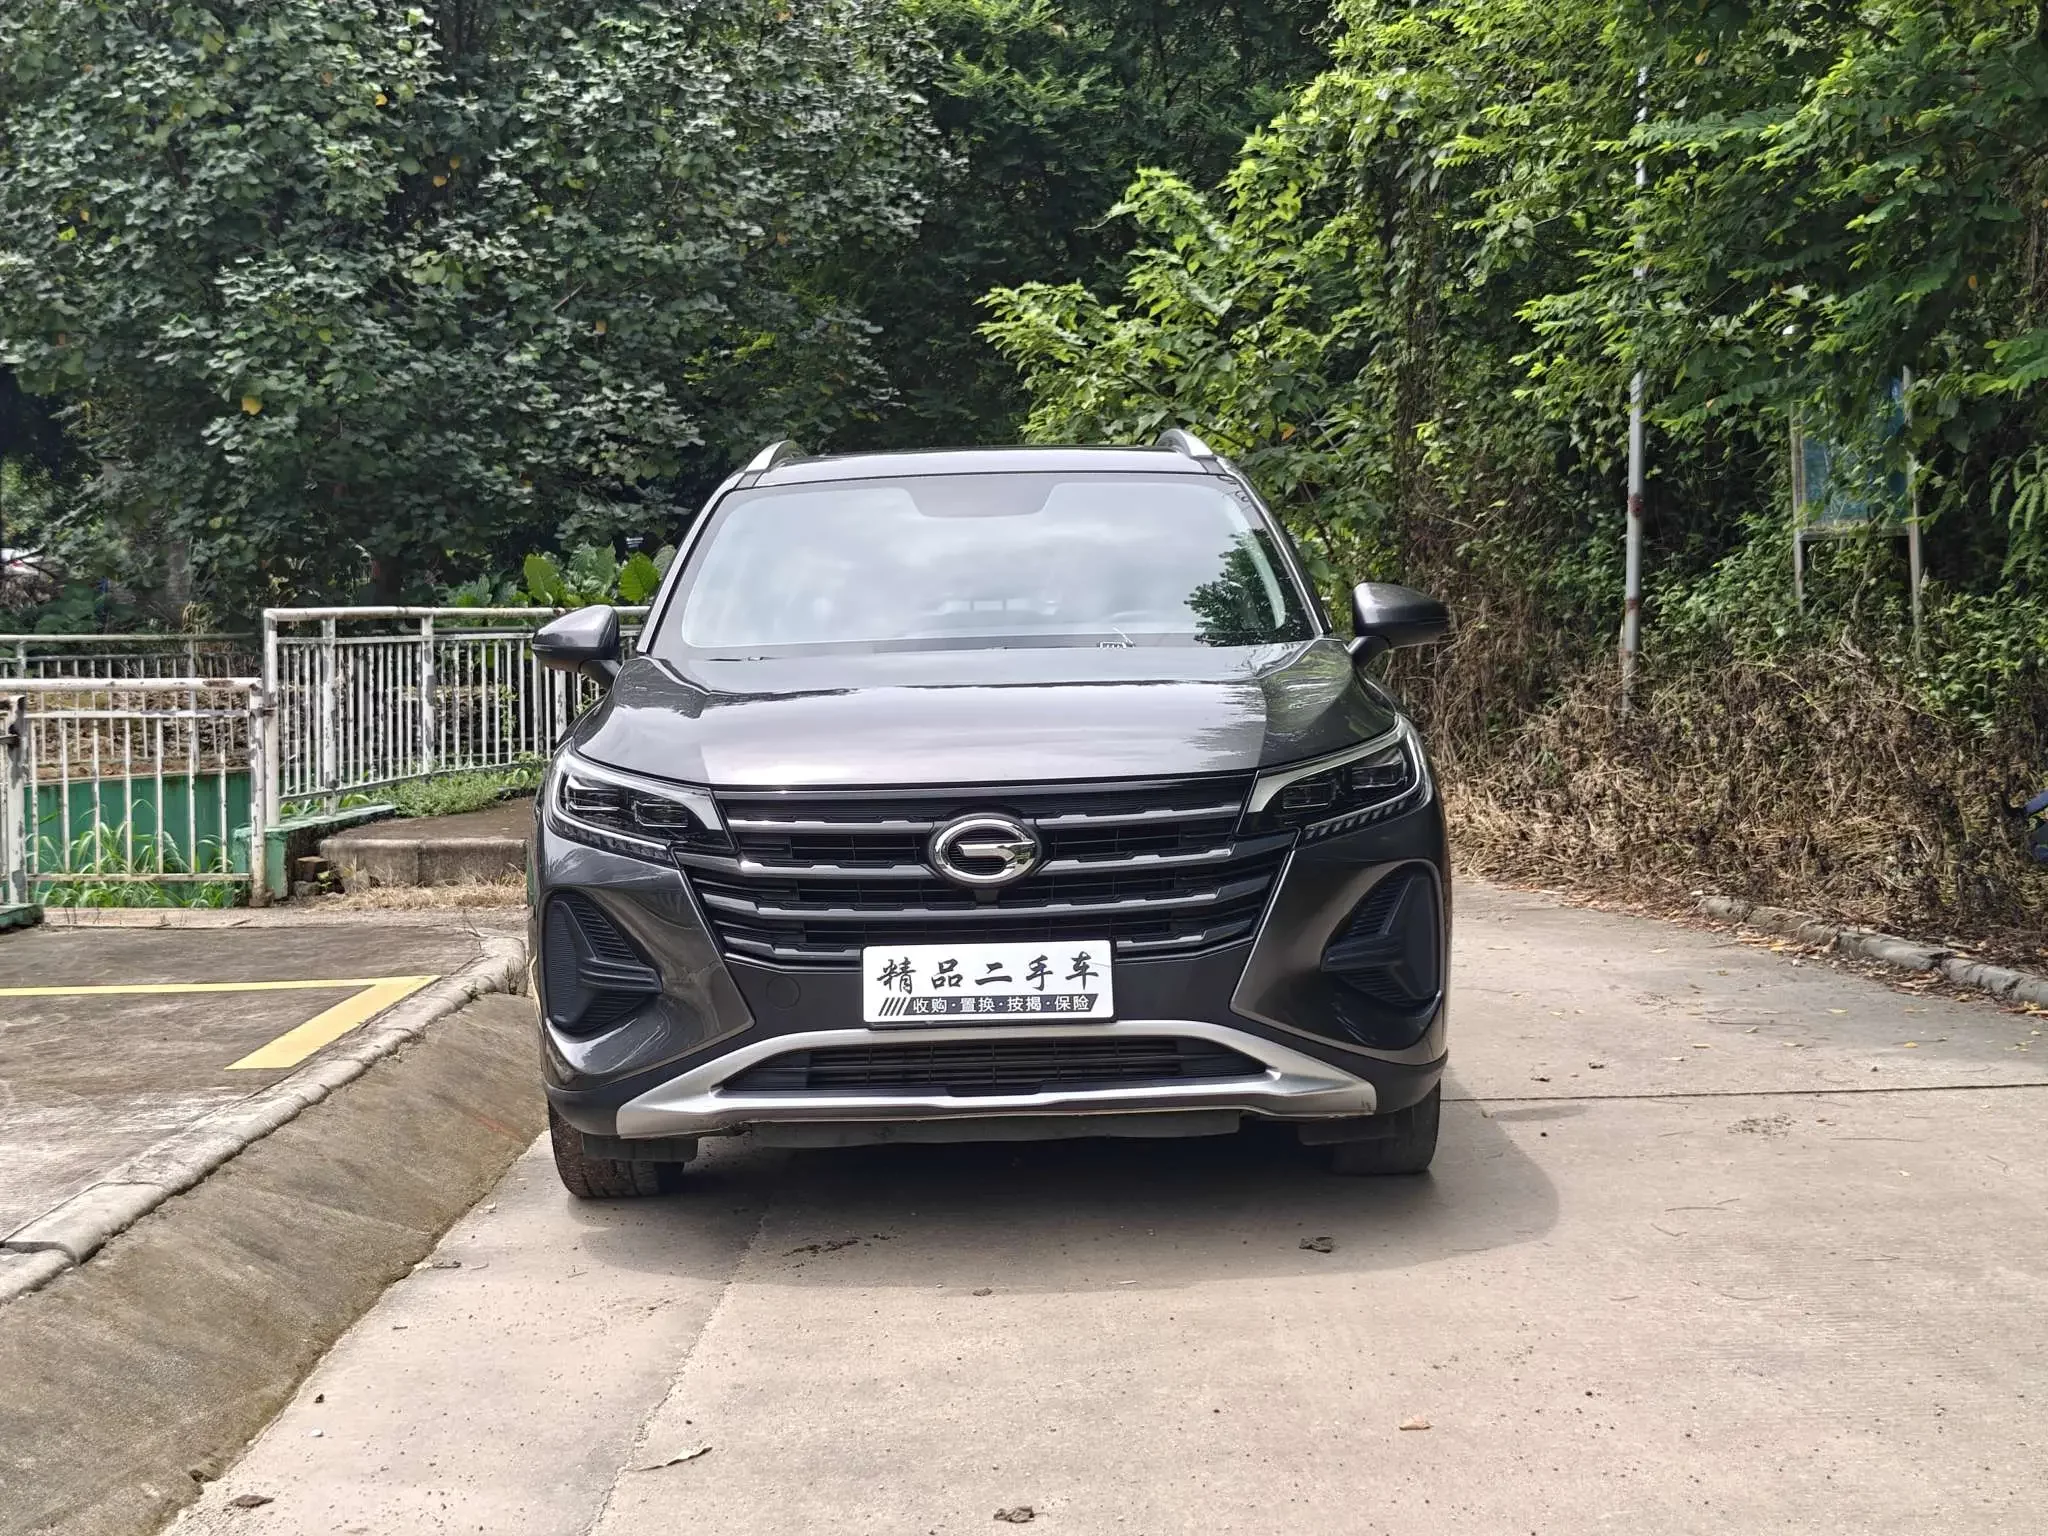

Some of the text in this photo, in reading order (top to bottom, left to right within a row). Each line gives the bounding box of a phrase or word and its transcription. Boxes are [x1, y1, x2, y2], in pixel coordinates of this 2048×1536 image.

[876, 951, 1099, 994] 精品二手车
